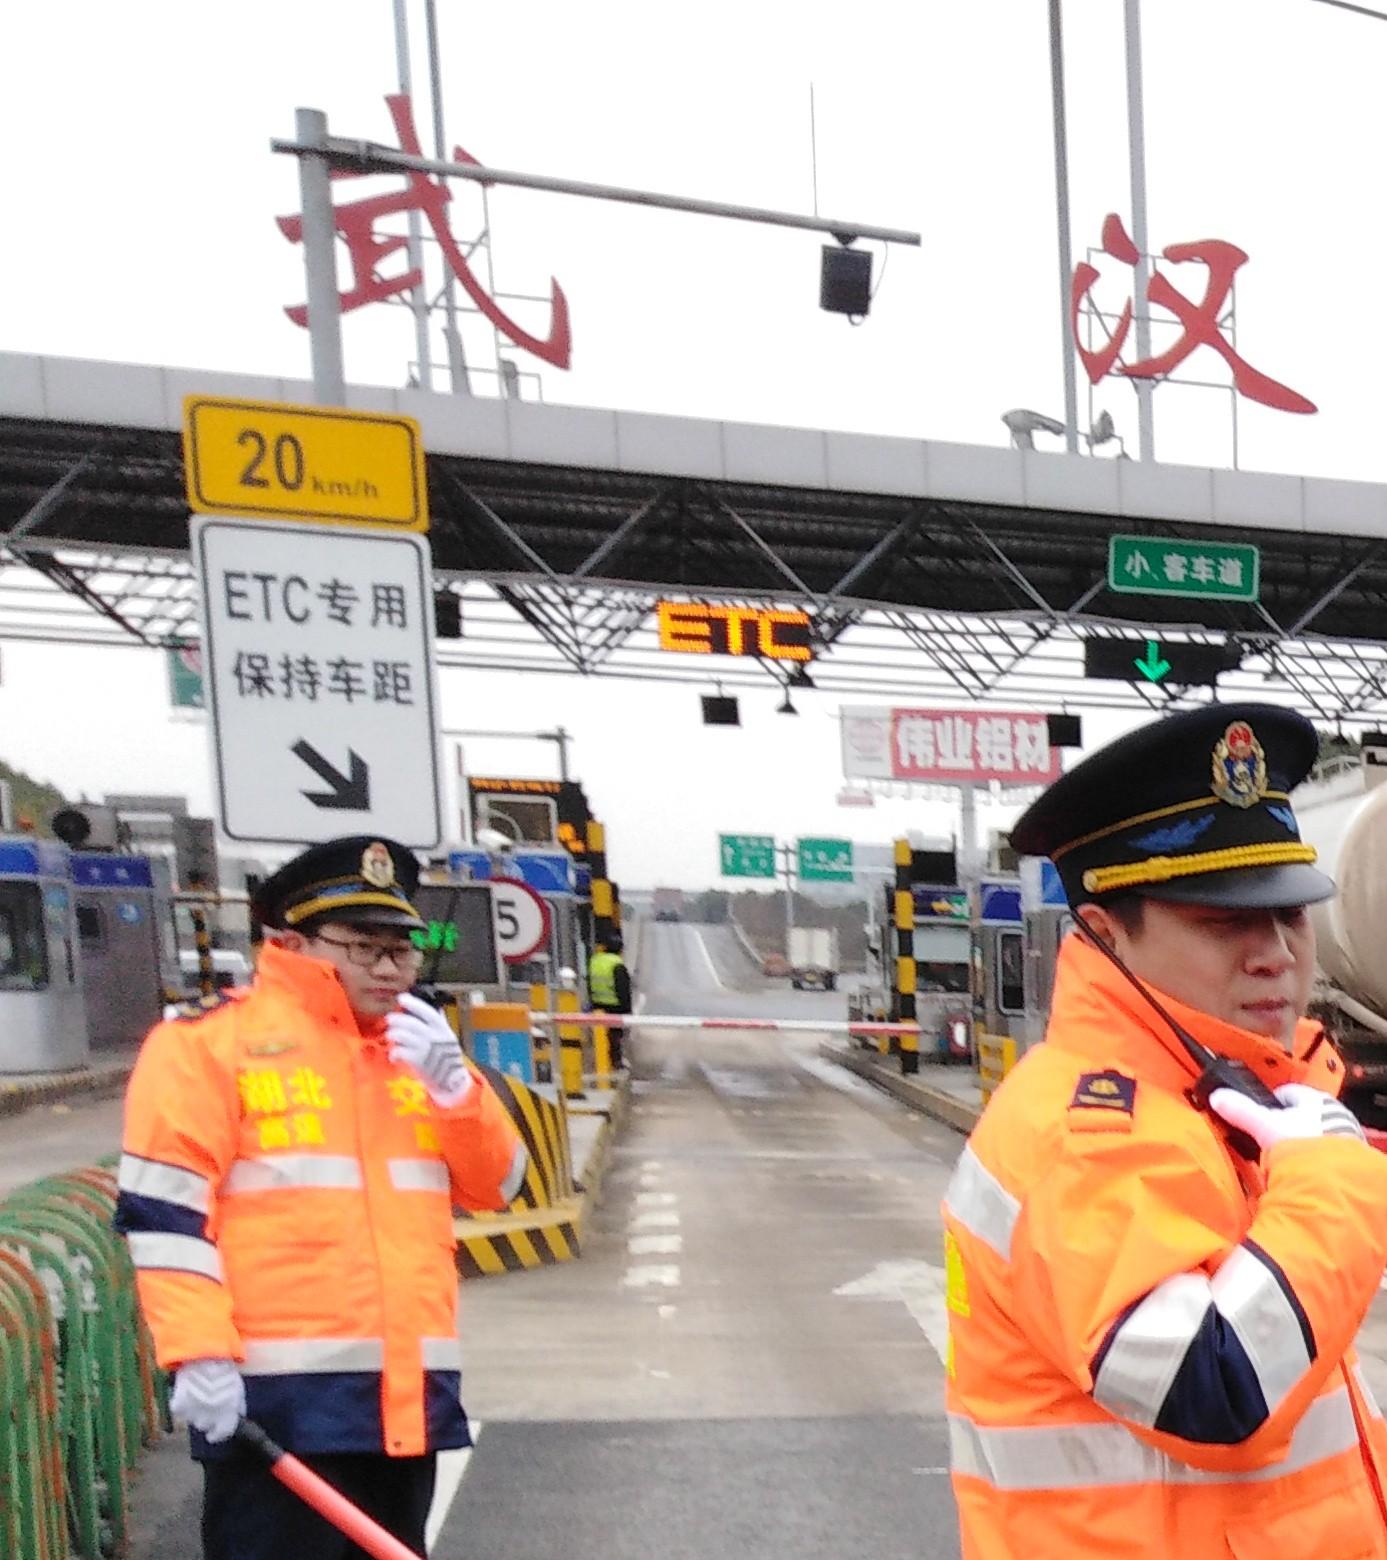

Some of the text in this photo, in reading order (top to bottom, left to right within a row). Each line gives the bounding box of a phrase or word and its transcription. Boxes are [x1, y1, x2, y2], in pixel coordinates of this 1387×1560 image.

[237, 429, 378, 499] 20 km/h
[1124, 549, 1243, 588] 小客车道
[222, 569, 408, 629] ETC专用
[656, 600, 813, 661] ETC
[233, 651, 414, 705] 保持车距
[897, 714, 1051, 773] 伟业铝材
[497, 900, 520, 940] 5
